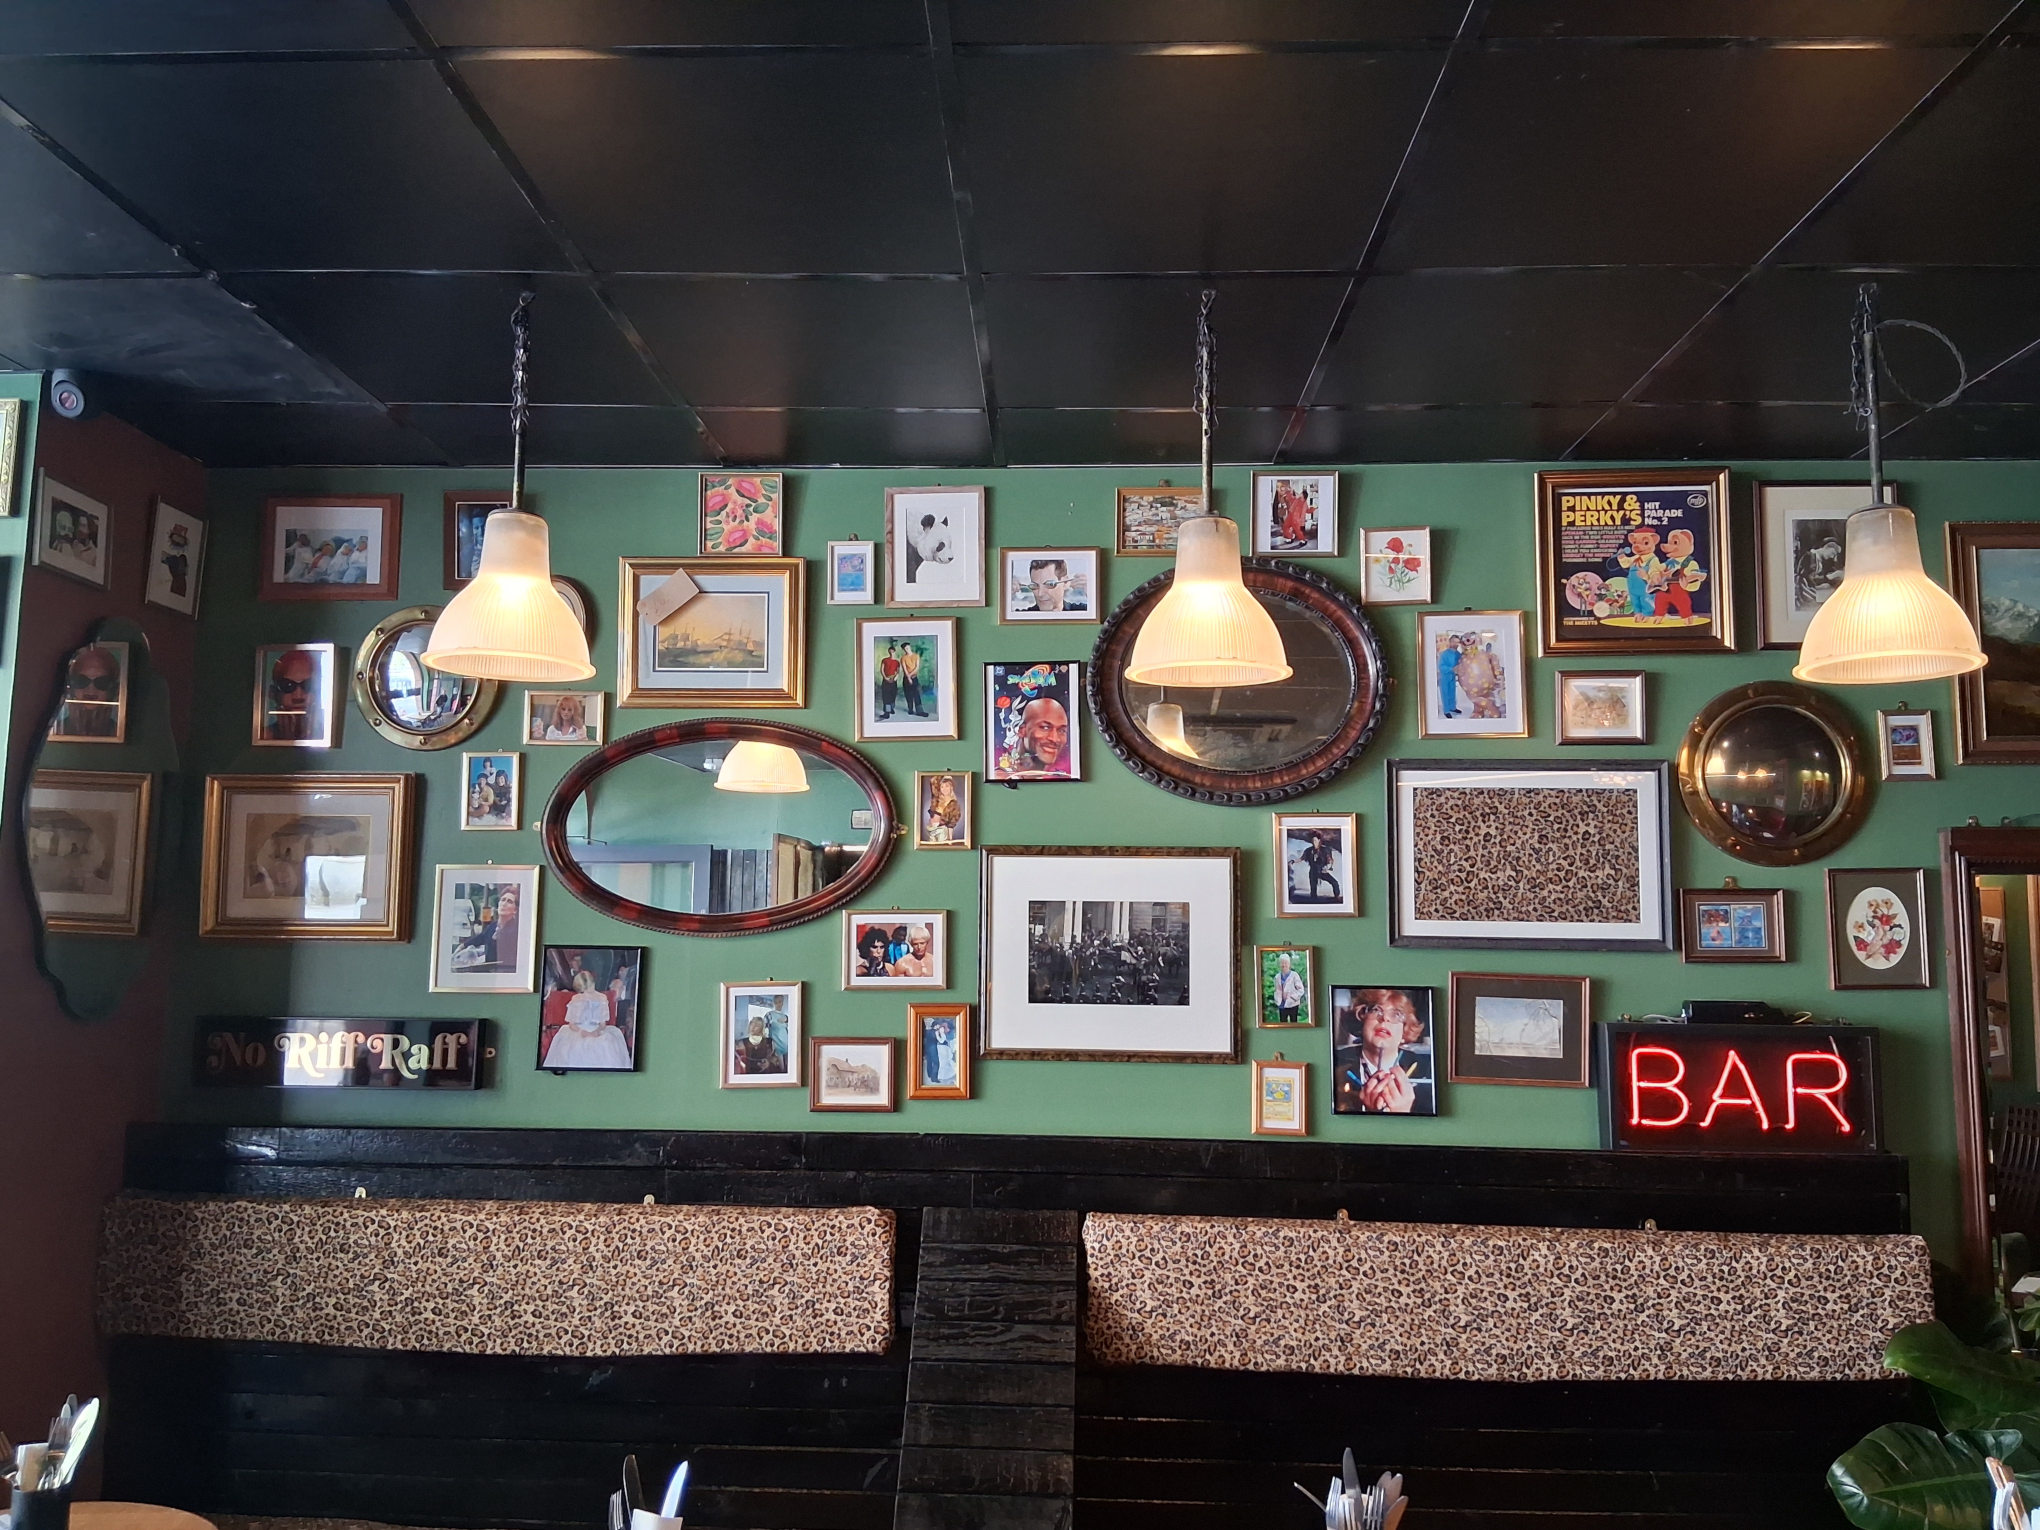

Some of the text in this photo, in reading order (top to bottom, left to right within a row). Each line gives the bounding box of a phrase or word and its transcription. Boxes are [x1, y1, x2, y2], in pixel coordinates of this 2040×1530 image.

[1561, 494, 1641, 510] PINKY &
[1644, 502, 1660, 510] HIT
[1561, 510, 1643, 526] PERKY'S
[1644, 509, 1683, 517] PARADE
[1644, 517, 1669, 526] No. 2
[206, 1031, 469, 1080] No Riff Raff
[1629, 1046, 1851, 1131] BAR
